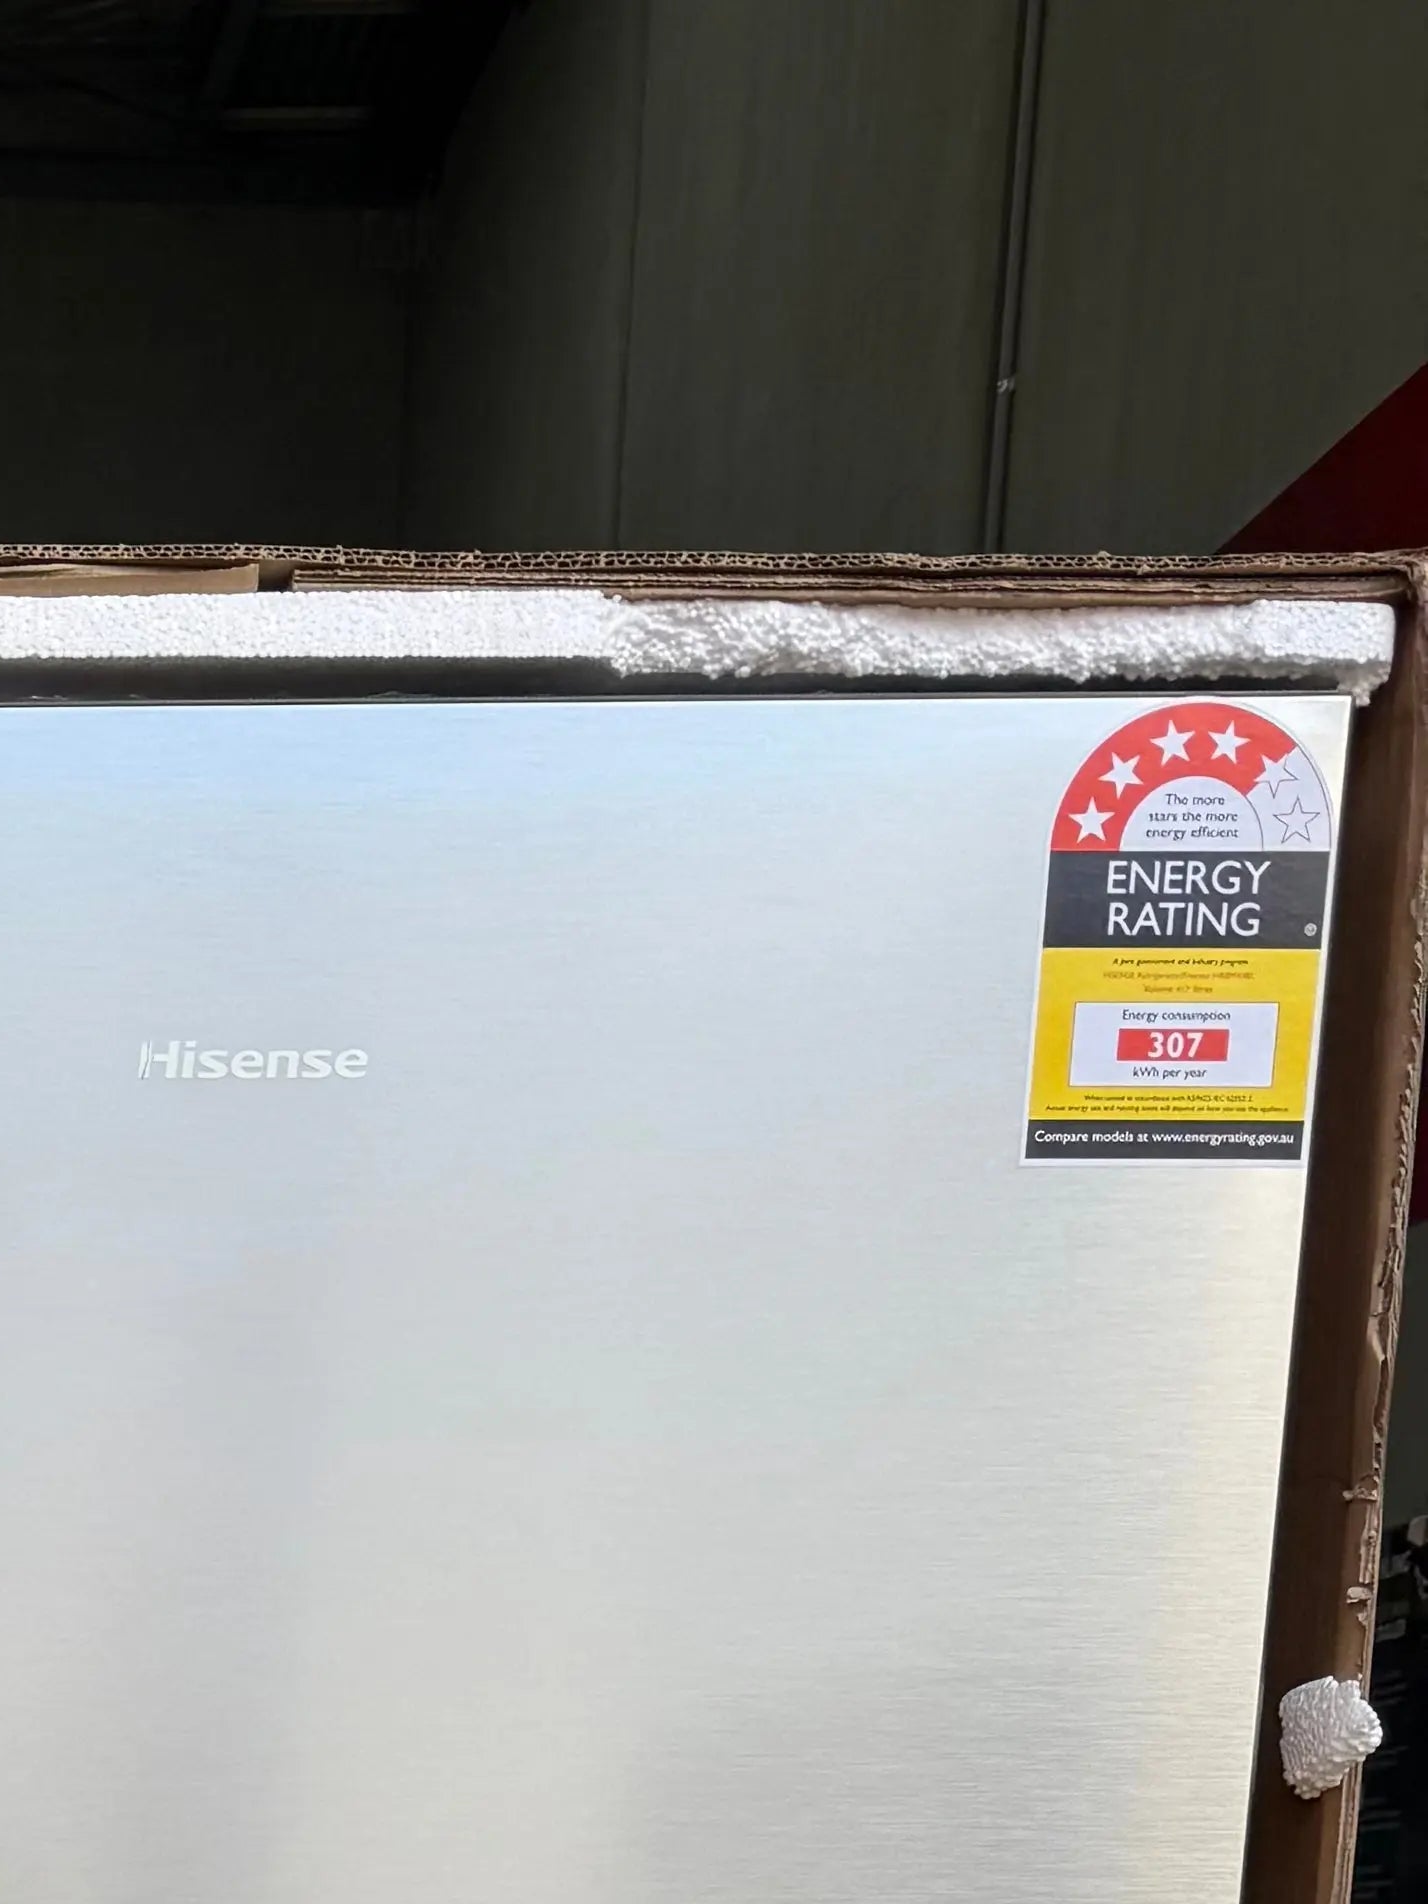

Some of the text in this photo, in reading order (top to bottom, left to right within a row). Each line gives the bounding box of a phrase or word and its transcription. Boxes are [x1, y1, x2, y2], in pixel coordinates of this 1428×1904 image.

[1165, 794, 1225, 806] The more
[1149, 811, 1239, 823] stars the more
[1146, 827, 1240, 841] energy efficient
[1107, 860, 1272, 895] ENERGY
[1107, 902, 1262, 937] RATING
[1122, 1009, 1231, 1024] Energy consumption
[1148, 1032, 1204, 1059] 307
[138, 1038, 369, 1080] Hisense
[1133, 1066, 1207, 1082] kWh per year
[1035, 1130, 1295, 1147] Compare models at www.energyrating.gov.au
